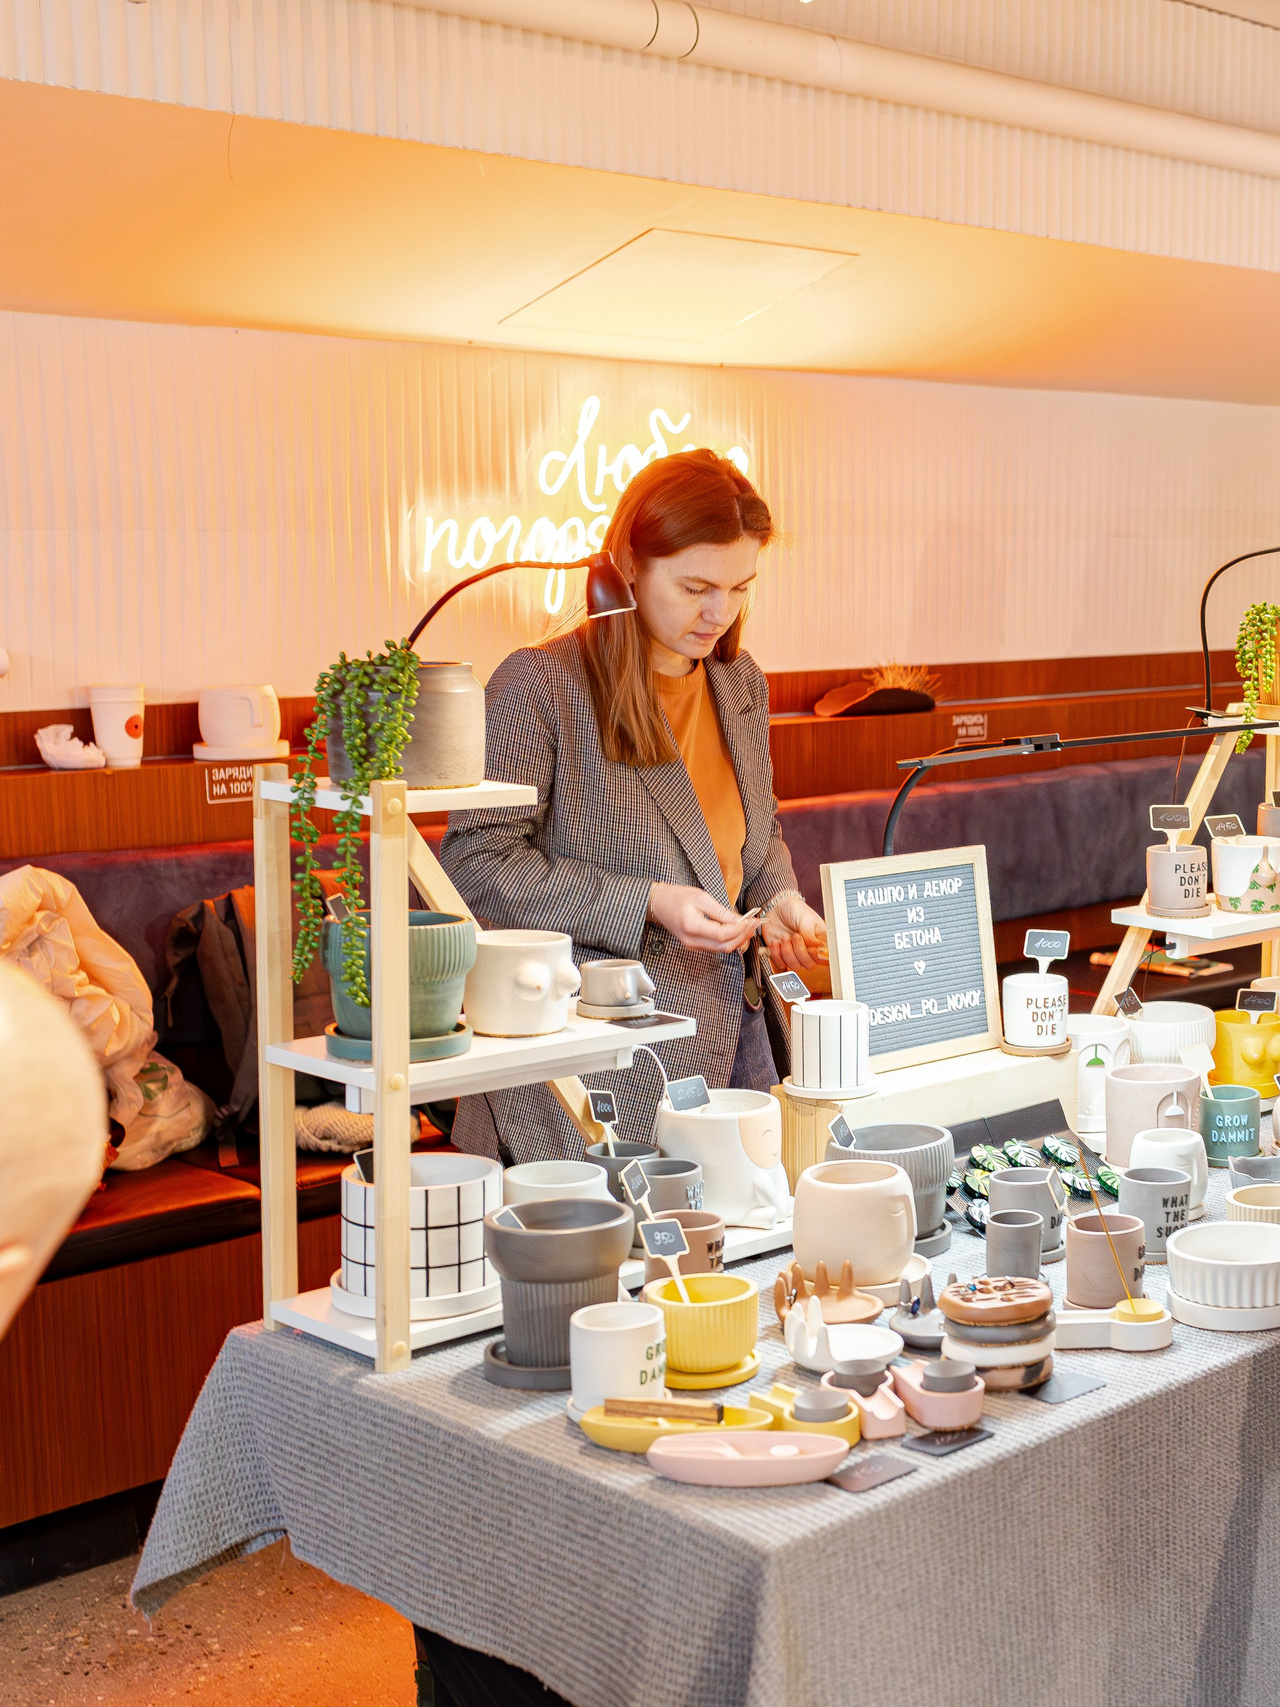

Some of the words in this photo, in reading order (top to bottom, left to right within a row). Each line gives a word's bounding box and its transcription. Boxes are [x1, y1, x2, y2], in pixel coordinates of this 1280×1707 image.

[212, 783, 227, 795] НА
[1179, 873, 1206, 887] DON'T
[857, 885, 905, 907] КАШПО
[907, 883, 918, 900] И
[923, 878, 963, 899] ДЕКОР
[1184, 887, 1202, 899] DIE
[906, 906, 925, 924] ИЗ
[893, 926, 943, 950] БЕТОНА
[1033, 937, 1062, 949] 1000
[1026, 994, 1067, 1010] PLEASE
[1032, 1008, 1064, 1023] DON'T
[1036, 1023, 1057, 1036] DIE
[1215, 1113, 1249, 1127] GROW
[1211, 1127, 1256, 1143] DAMMIT
[1161, 1194, 1189, 1208] WHAT
[1164, 1209, 1186, 1223] THE
[653, 1231, 676, 1246] 950
